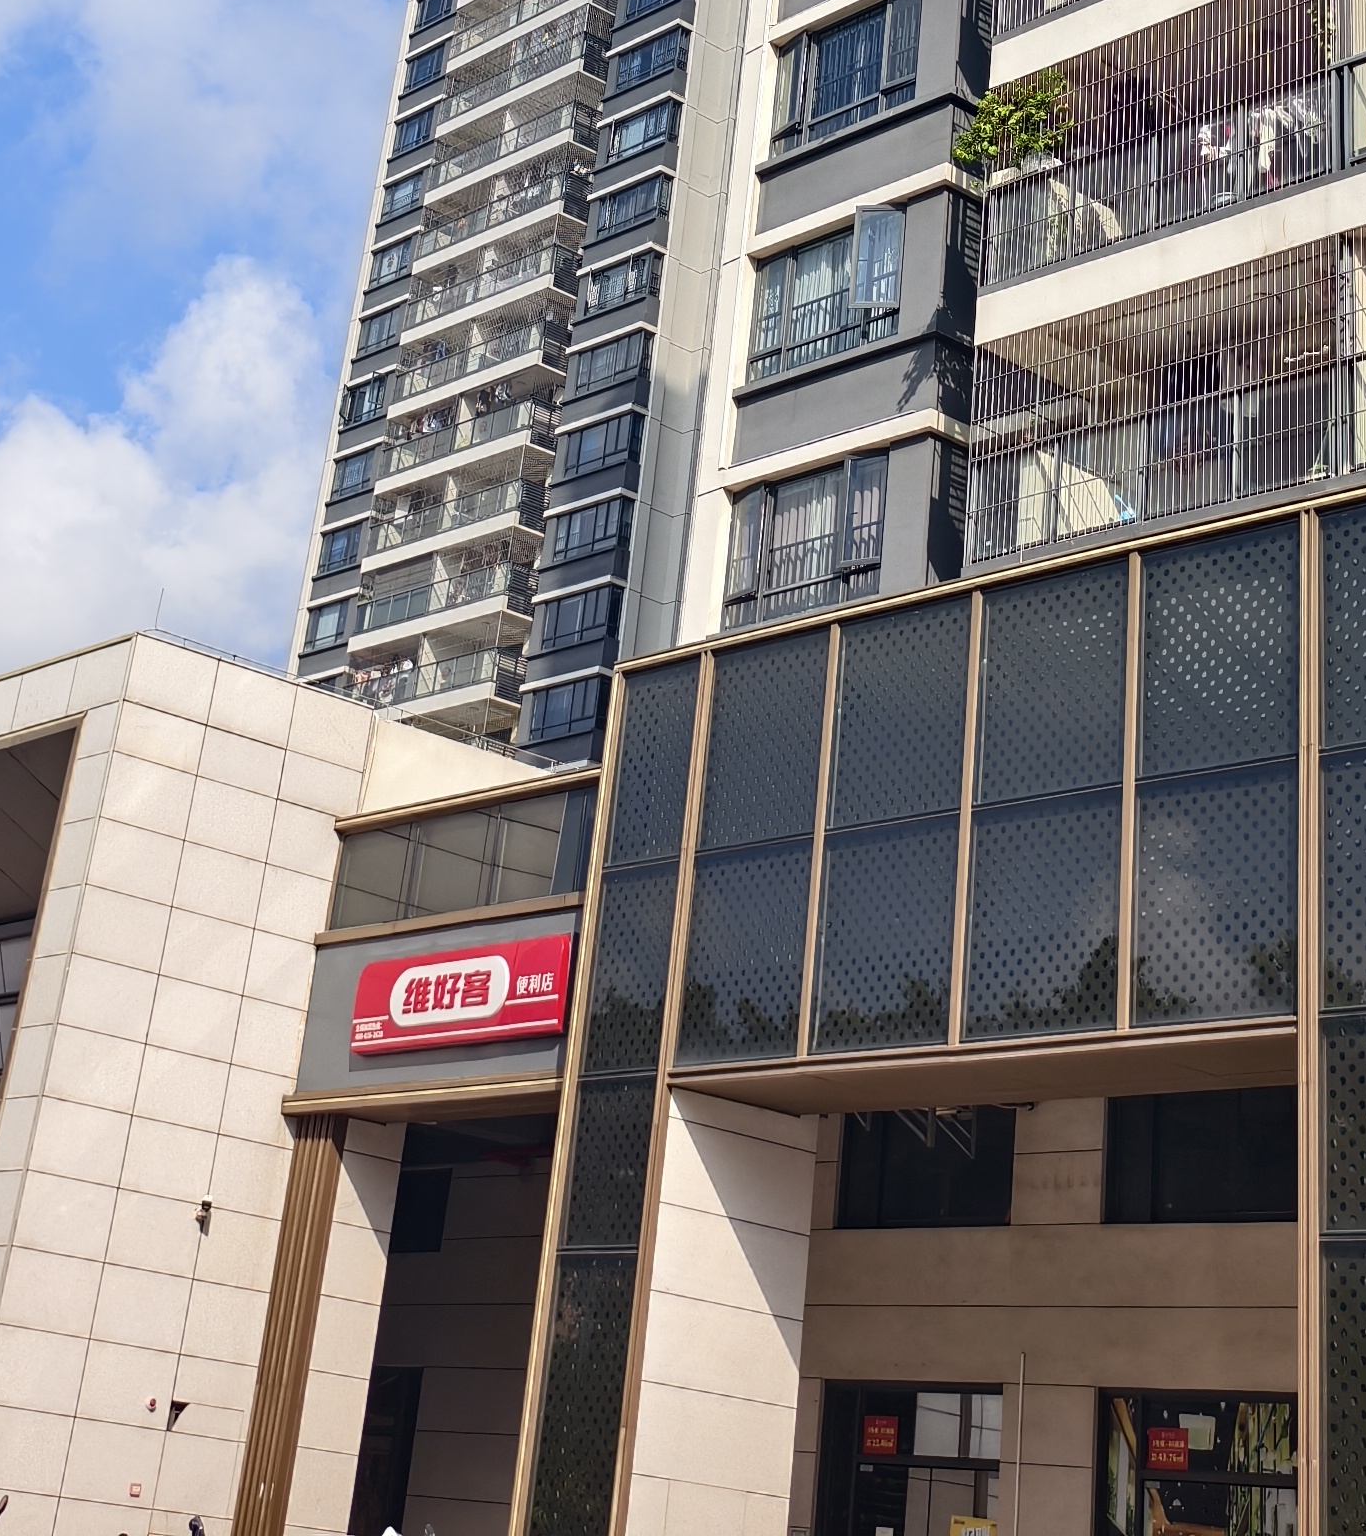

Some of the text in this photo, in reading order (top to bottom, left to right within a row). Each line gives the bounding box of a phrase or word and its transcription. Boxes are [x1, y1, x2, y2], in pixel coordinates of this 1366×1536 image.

[402, 970, 491, 1015] 维好客
[516, 972, 554, 995] 便利店
